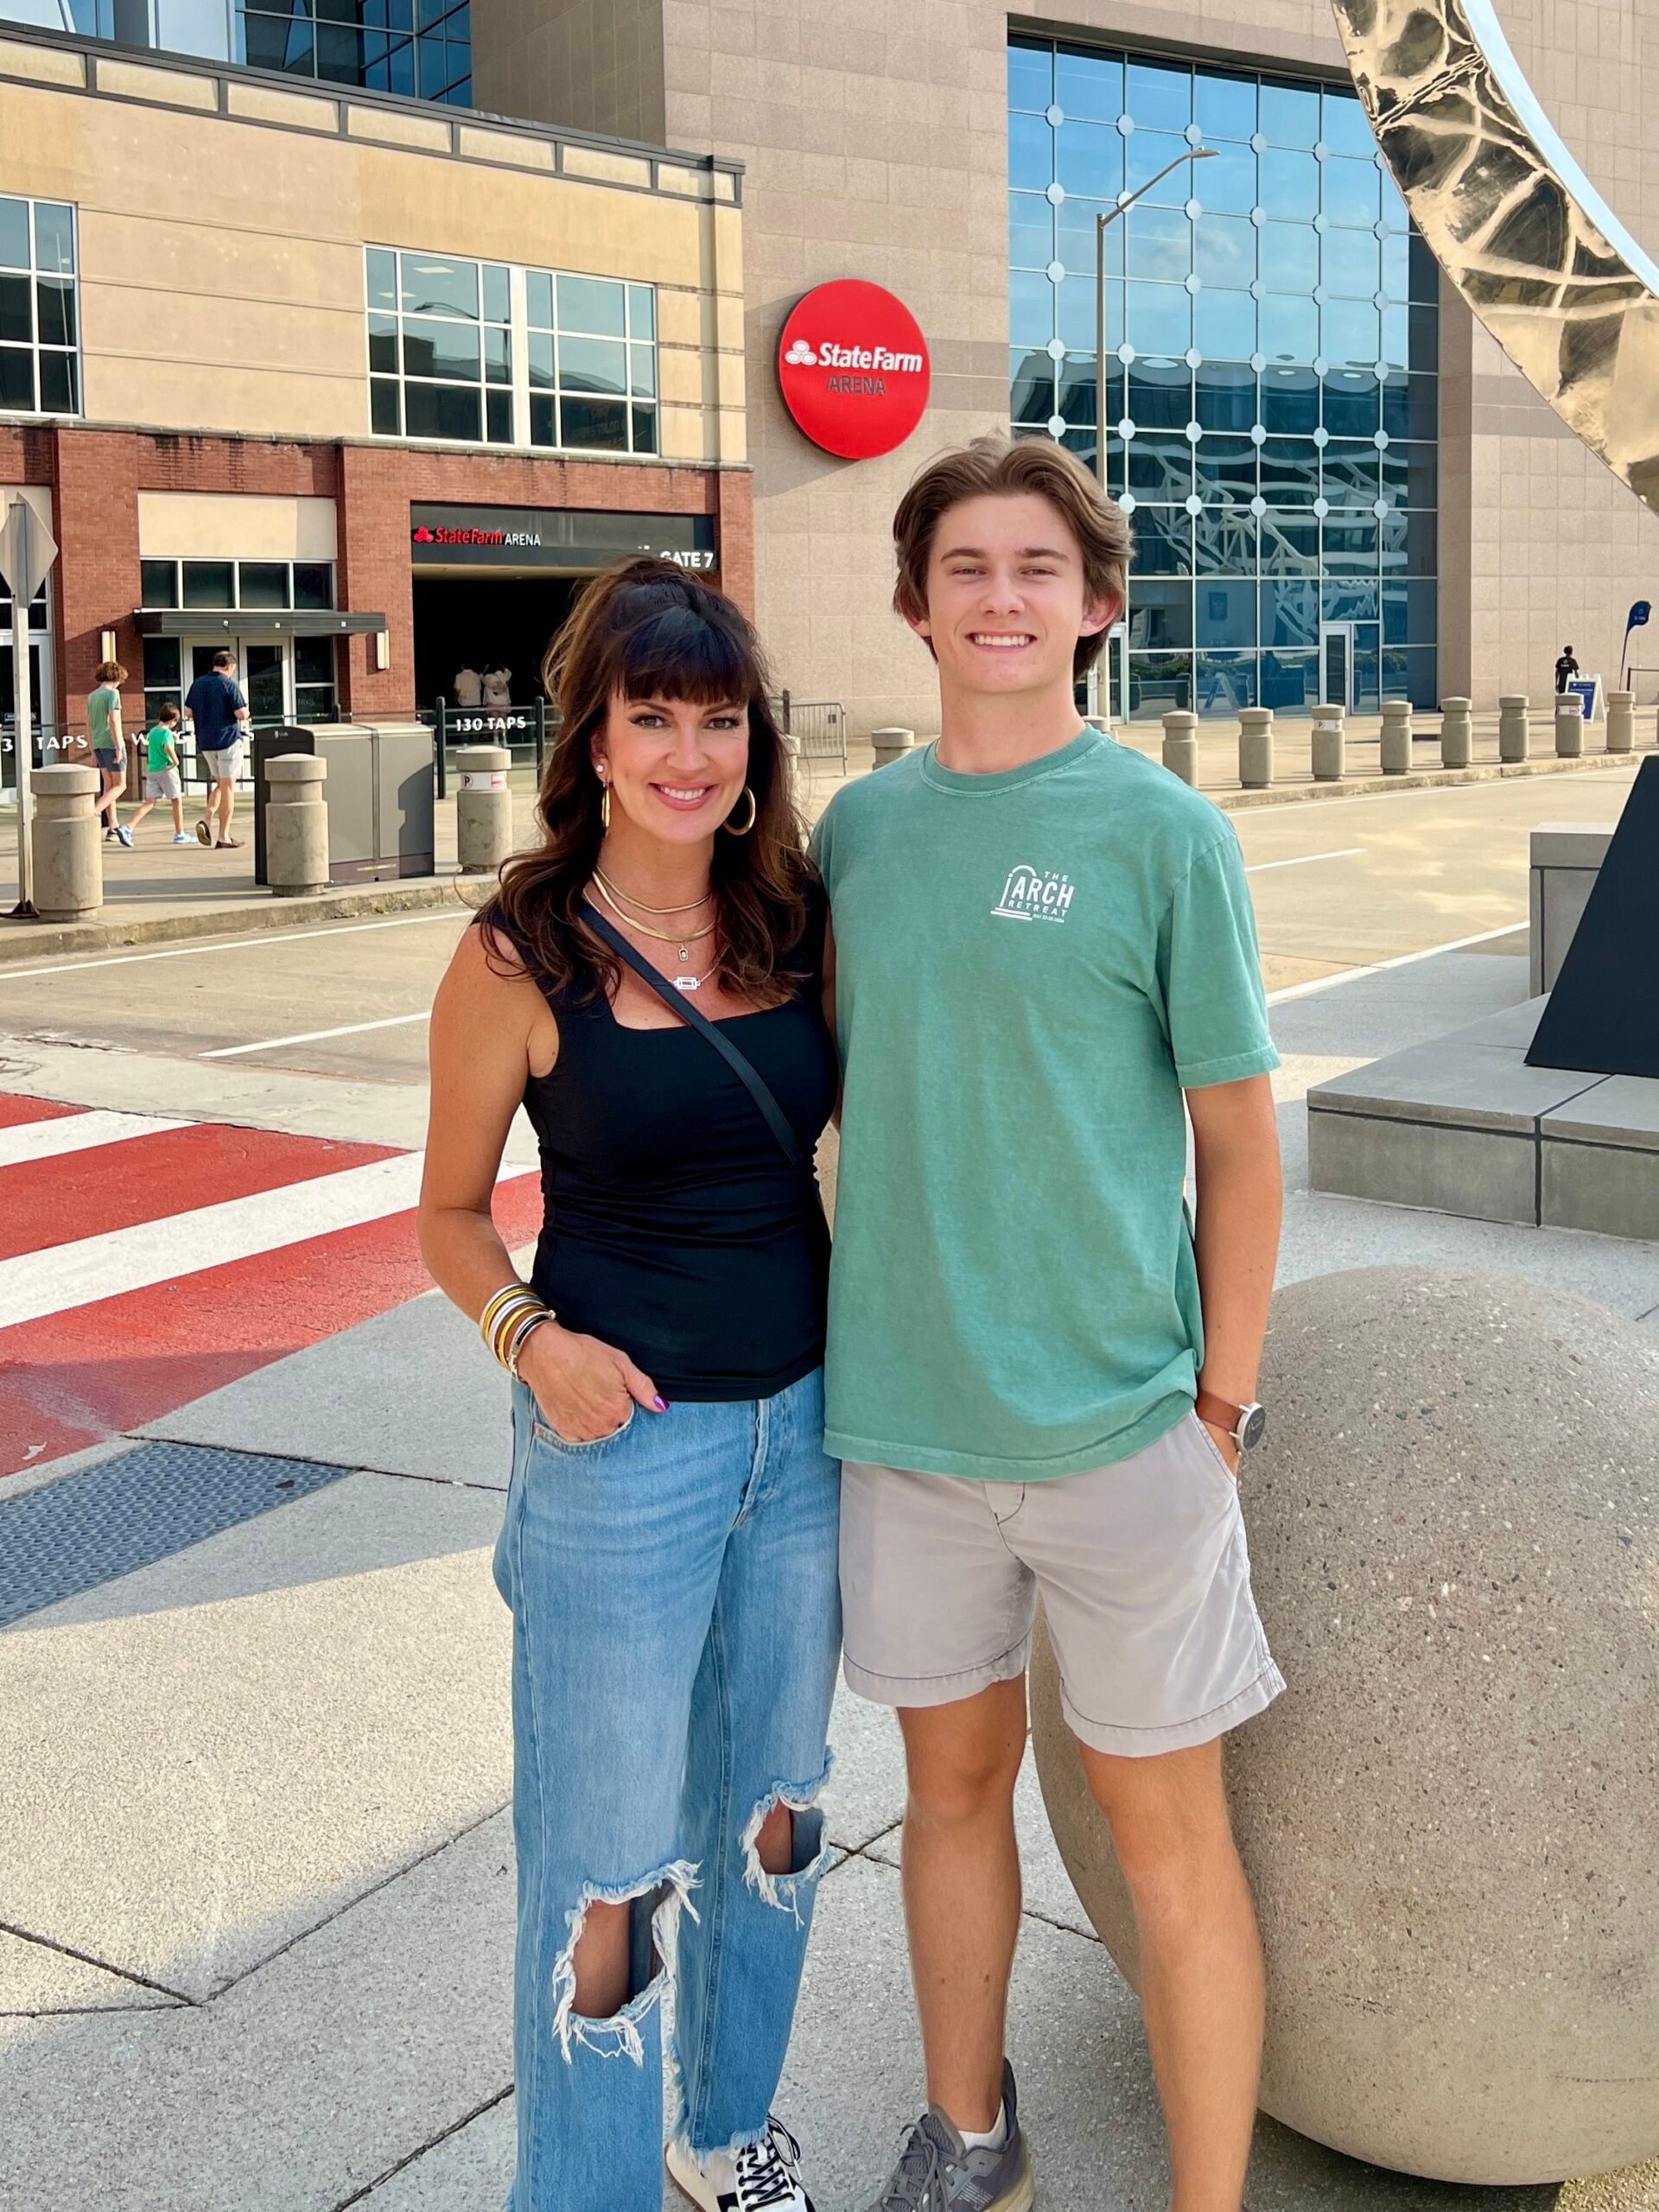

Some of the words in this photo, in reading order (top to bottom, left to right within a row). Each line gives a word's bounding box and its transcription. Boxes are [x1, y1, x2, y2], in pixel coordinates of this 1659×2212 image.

[828, 375, 886, 396] ARENA
[505, 533, 542, 546] ARENA
[704, 552, 714, 568] 7
[456, 718, 483, 732] 130
[487, 716, 526, 730] TAPS
[36, 734, 88, 750] TAPS
[1044, 871, 1069, 882] THE
[1011, 876, 1075, 908] ARCH
[1007, 899, 1068, 917] RETREAT
